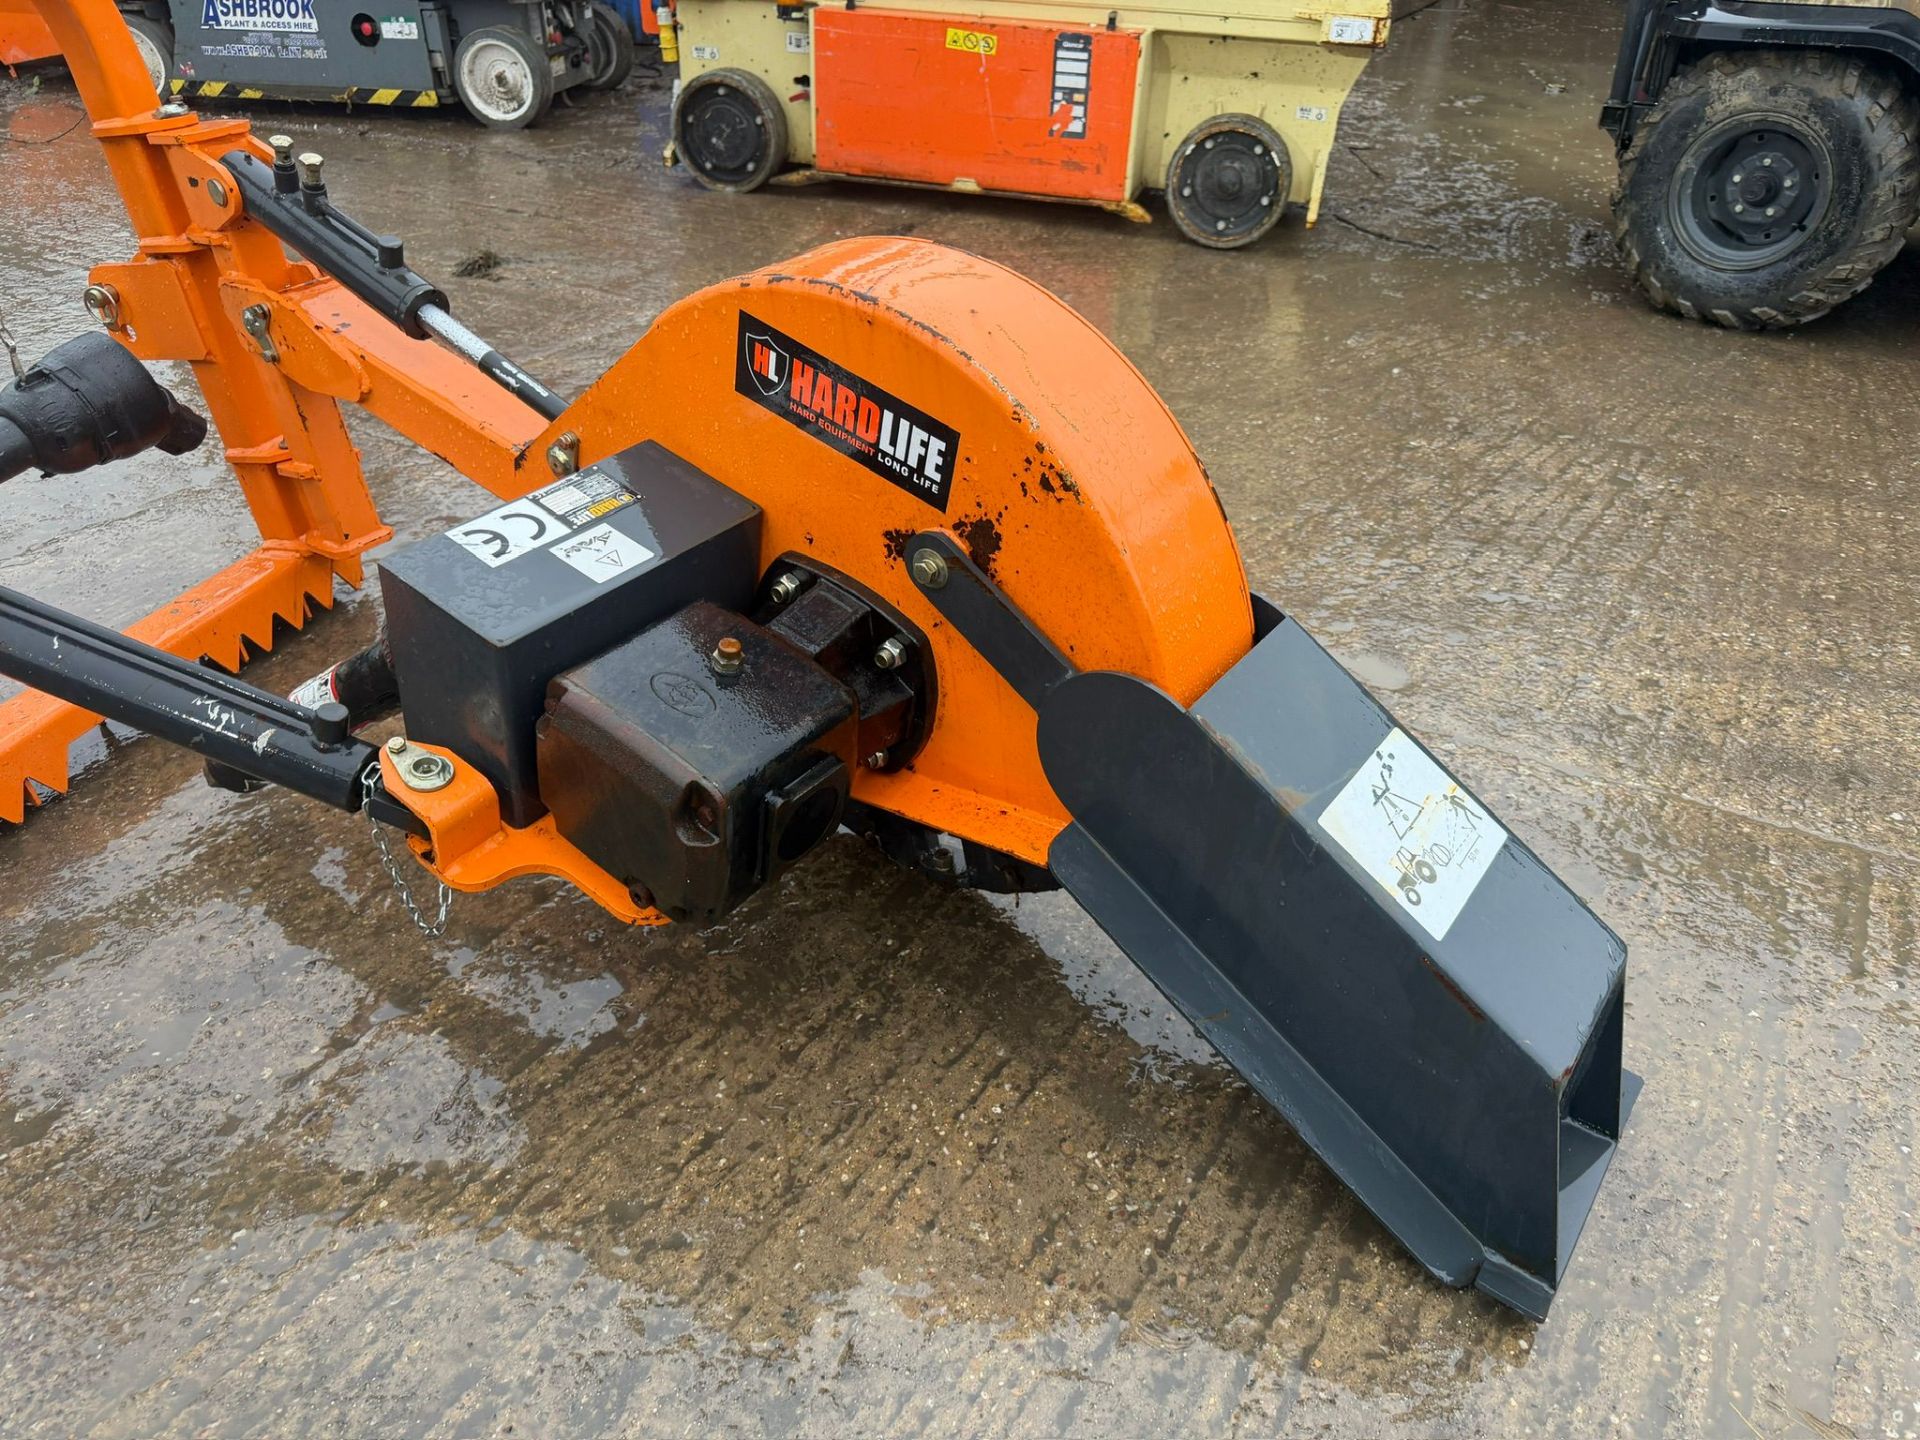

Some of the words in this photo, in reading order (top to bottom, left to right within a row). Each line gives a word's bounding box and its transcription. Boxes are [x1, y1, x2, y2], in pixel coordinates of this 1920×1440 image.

[203, 0, 315, 27] ASHBROOK
[224, 20, 250, 28] PLANT
[261, 20, 292, 29] ACCESS
[294, 21, 313, 30] HIRE
[754, 342, 779, 383] HL
[789, 402, 816, 422] HARD
[818, 419, 876, 457] EQUIPMENT
[878, 452, 909, 477] LONG
[913, 472, 940, 494] LIFE
